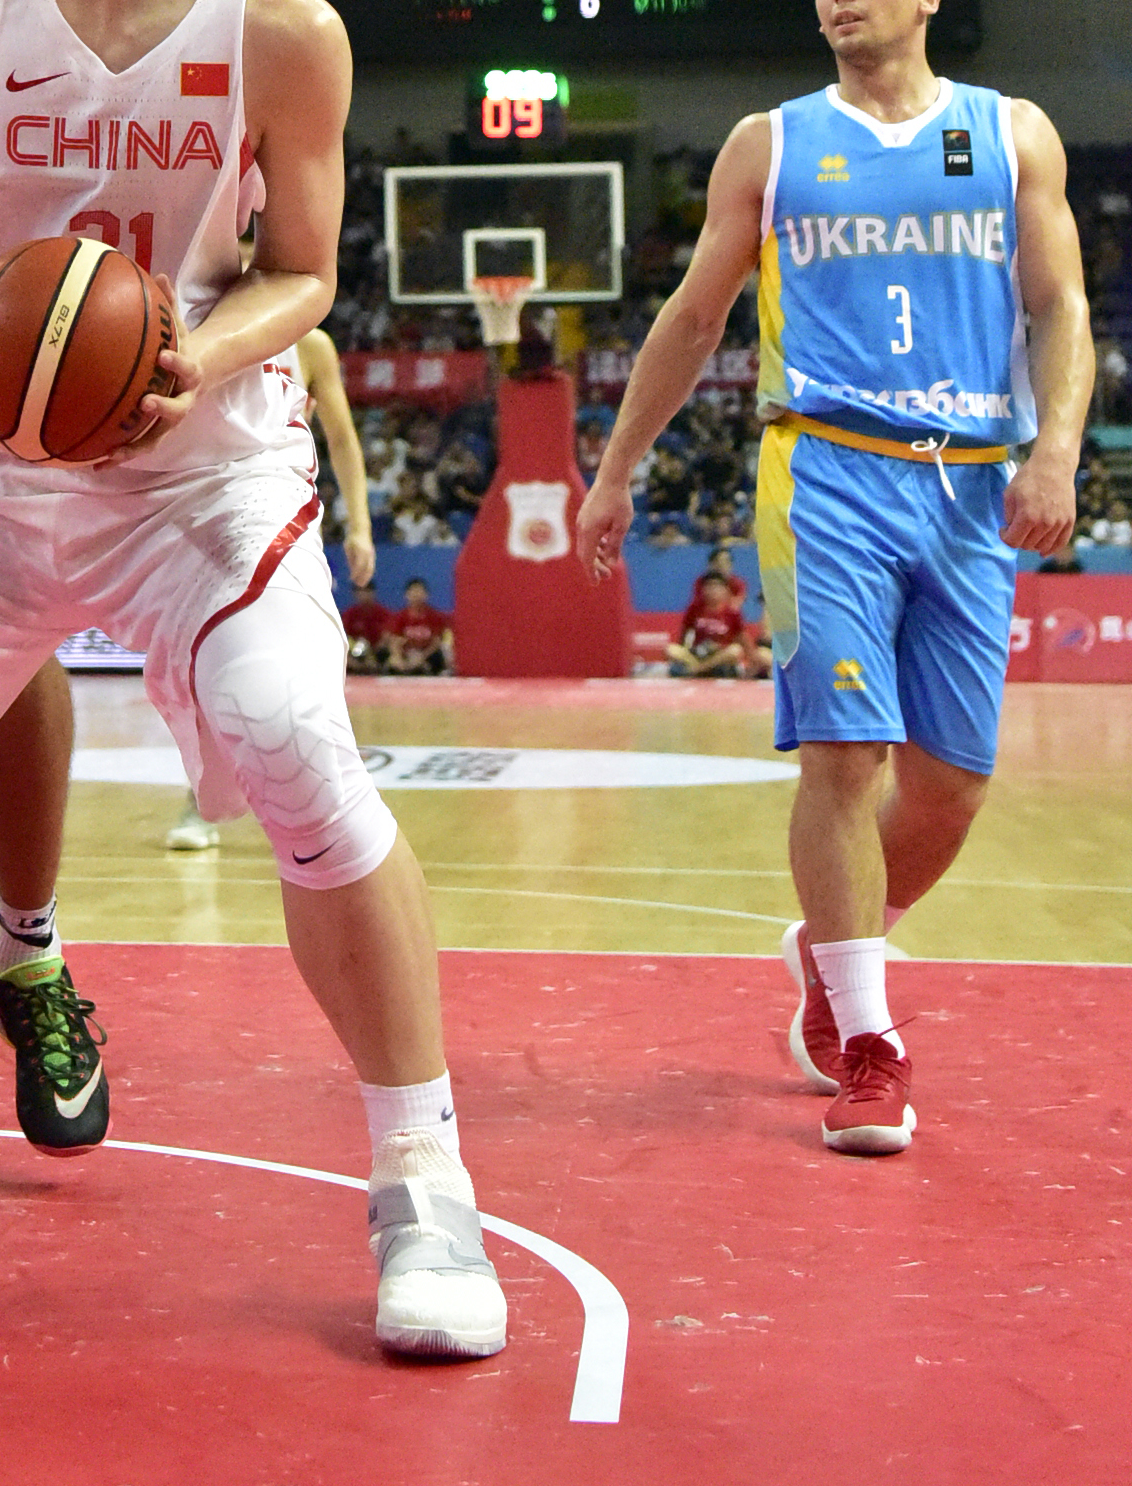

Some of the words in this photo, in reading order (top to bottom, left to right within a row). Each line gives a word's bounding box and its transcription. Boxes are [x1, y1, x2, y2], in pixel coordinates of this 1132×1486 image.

[6, 114, 223, 170] CHINA
[482, 96, 543, 138] 09
[948, 154, 969, 164] FIBA
[785, 211, 1006, 265] UKRAINE
[887, 285, 913, 354] 3
